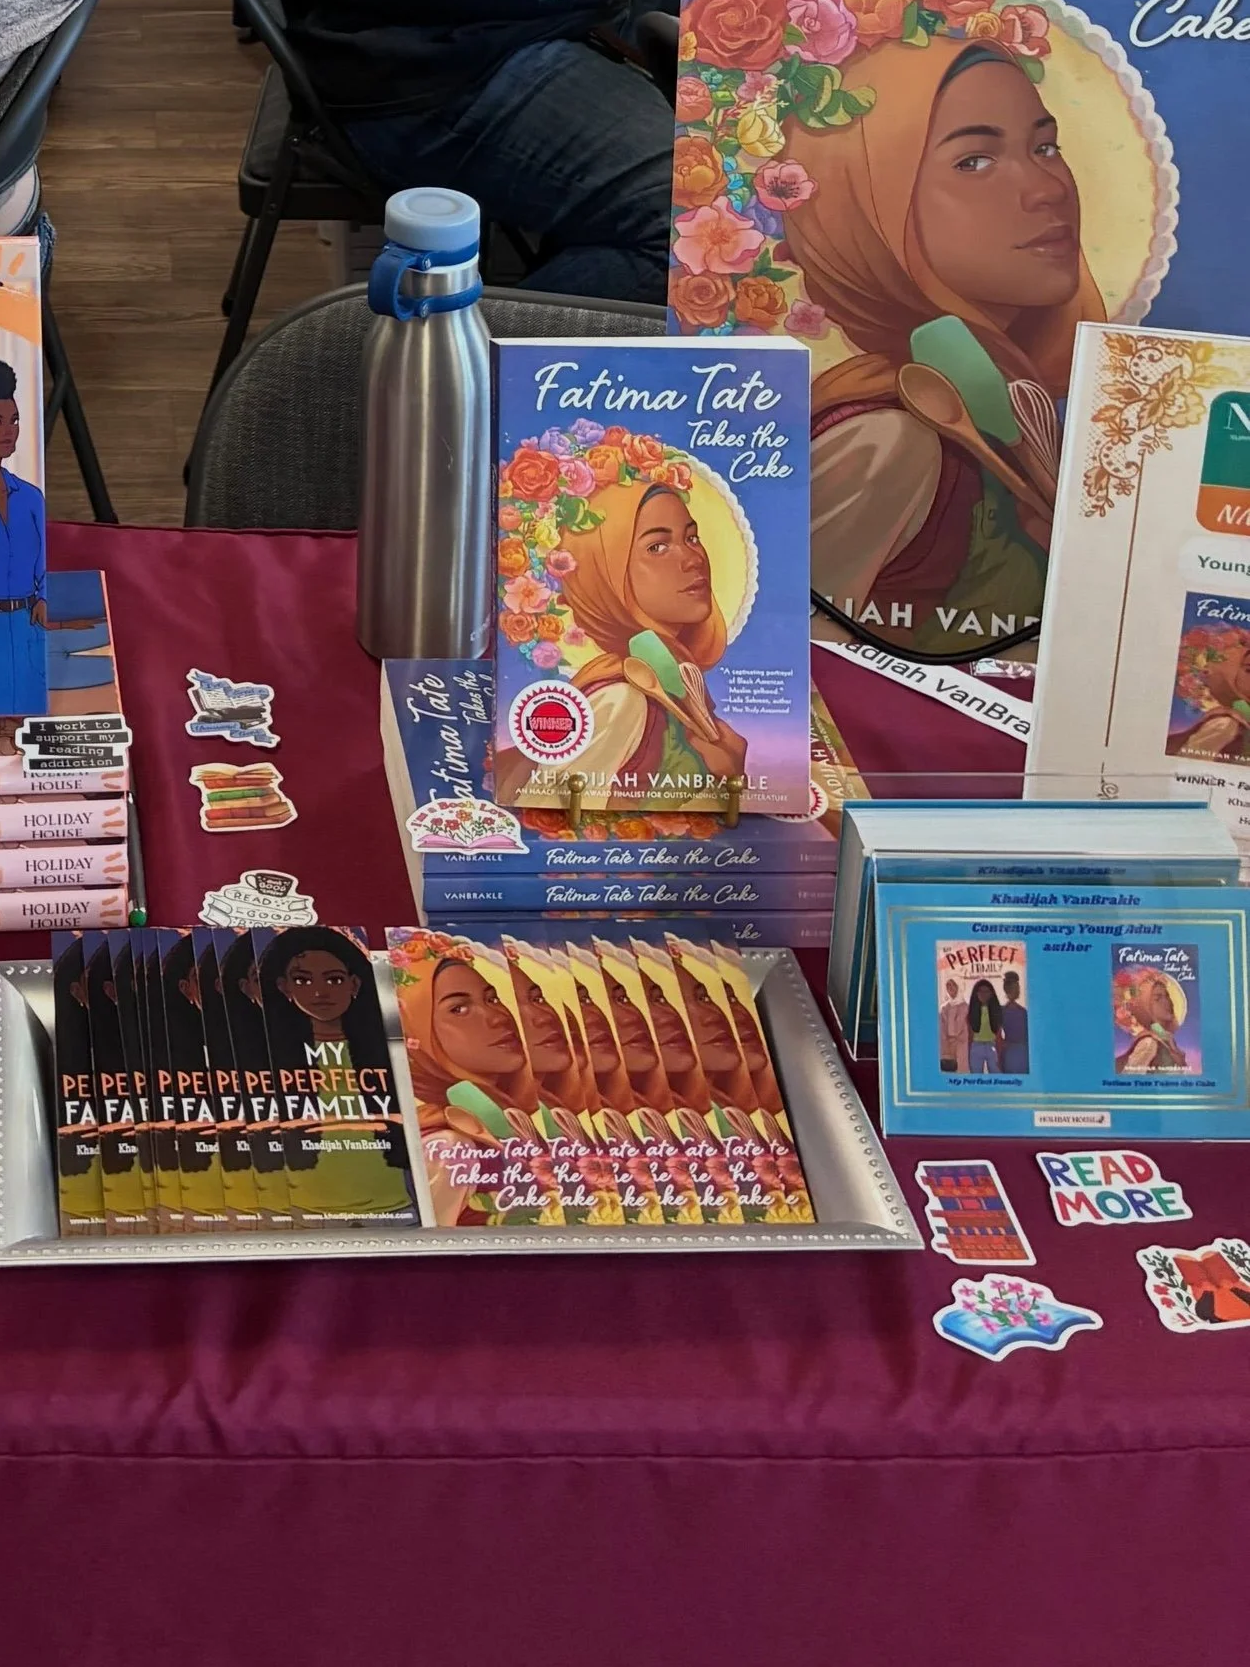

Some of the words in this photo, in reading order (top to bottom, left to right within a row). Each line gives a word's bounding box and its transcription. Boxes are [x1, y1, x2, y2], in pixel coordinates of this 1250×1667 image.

[534, 361, 688, 412] Fatima
[691, 363, 782, 415] Tate
[687, 420, 747, 449] Takes
[750, 421, 789, 449] the
[728, 450, 793, 483] Cake
[39, 722, 47, 731] I
[55, 721, 86, 731] work
[96, 720, 111, 729] to
[35, 733, 91, 743] support
[99, 733, 116, 743] my
[49, 744, 105, 756] reading
[40, 758, 113, 769] addiction
[24, 812, 93, 827] HOLIDAY
[32, 829, 83, 840] HOUSE
[234, 892, 272, 906] READ
[444, 892, 503, 900] VANBRAKLE
[546, 885, 601, 904] Fatima
[603, 885, 634, 903] Tate
[637, 885, 678, 904] Takes
[684, 885, 711, 903] the
[713, 884, 760, 904] Cake
[991, 893, 1057, 906] Khadijah
[1061, 894, 1140, 906] VanBrakle
[247, 911, 292, 922] GOOD
[971, 922, 1075, 936] Contemporary
[1078, 923, 1124, 936] Young
[1124, 924, 1163, 935] Adult
[1043, 941, 1092, 953] author
[304, 1042, 345, 1066] MY
[279, 1068, 388, 1093] PERFECT
[285, 1095, 392, 1120] FAMILY
[302, 1140, 343, 1152] Khadijah
[345, 1139, 392, 1150] VanBrakle
[425, 1139, 500, 1162] Fatima
[500, 1137, 543, 1160] Tate
[447, 1165, 499, 1186] Takes
[503, 1163, 535, 1185] the
[1041, 1154, 1155, 1186] READ
[495, 1186, 551, 1212] Cake
[1055, 1186, 1185, 1222] MORE
